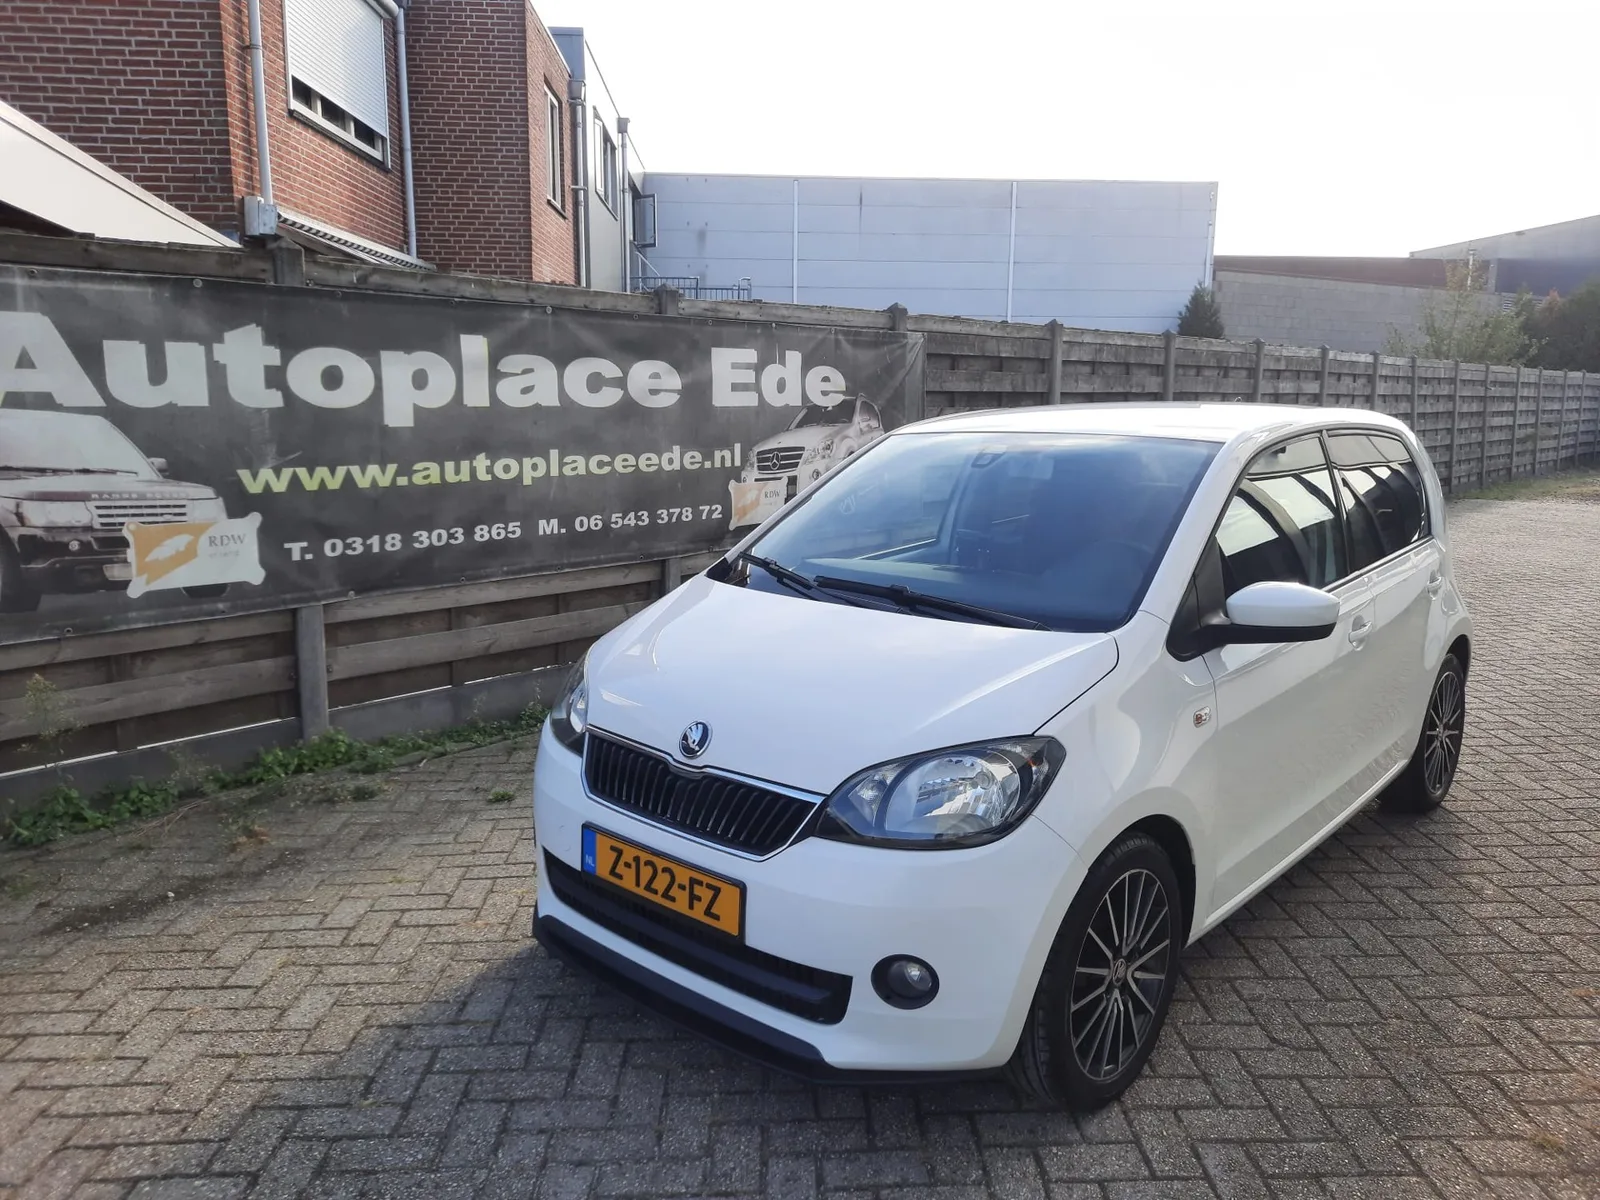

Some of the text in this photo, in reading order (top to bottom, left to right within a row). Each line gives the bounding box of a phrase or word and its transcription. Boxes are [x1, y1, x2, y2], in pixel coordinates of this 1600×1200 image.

[0, 311, 847, 428] Autoplace Ede
[236, 442, 742, 494] www.autoplaceede.nl
[208, 533, 247, 548] RDW
[283, 504, 723, 561] T. 0318 303 865 M. 06 543 378 72
[585, 854, 595, 868] NL
[608, 845, 722, 922] Z-122-FZ
